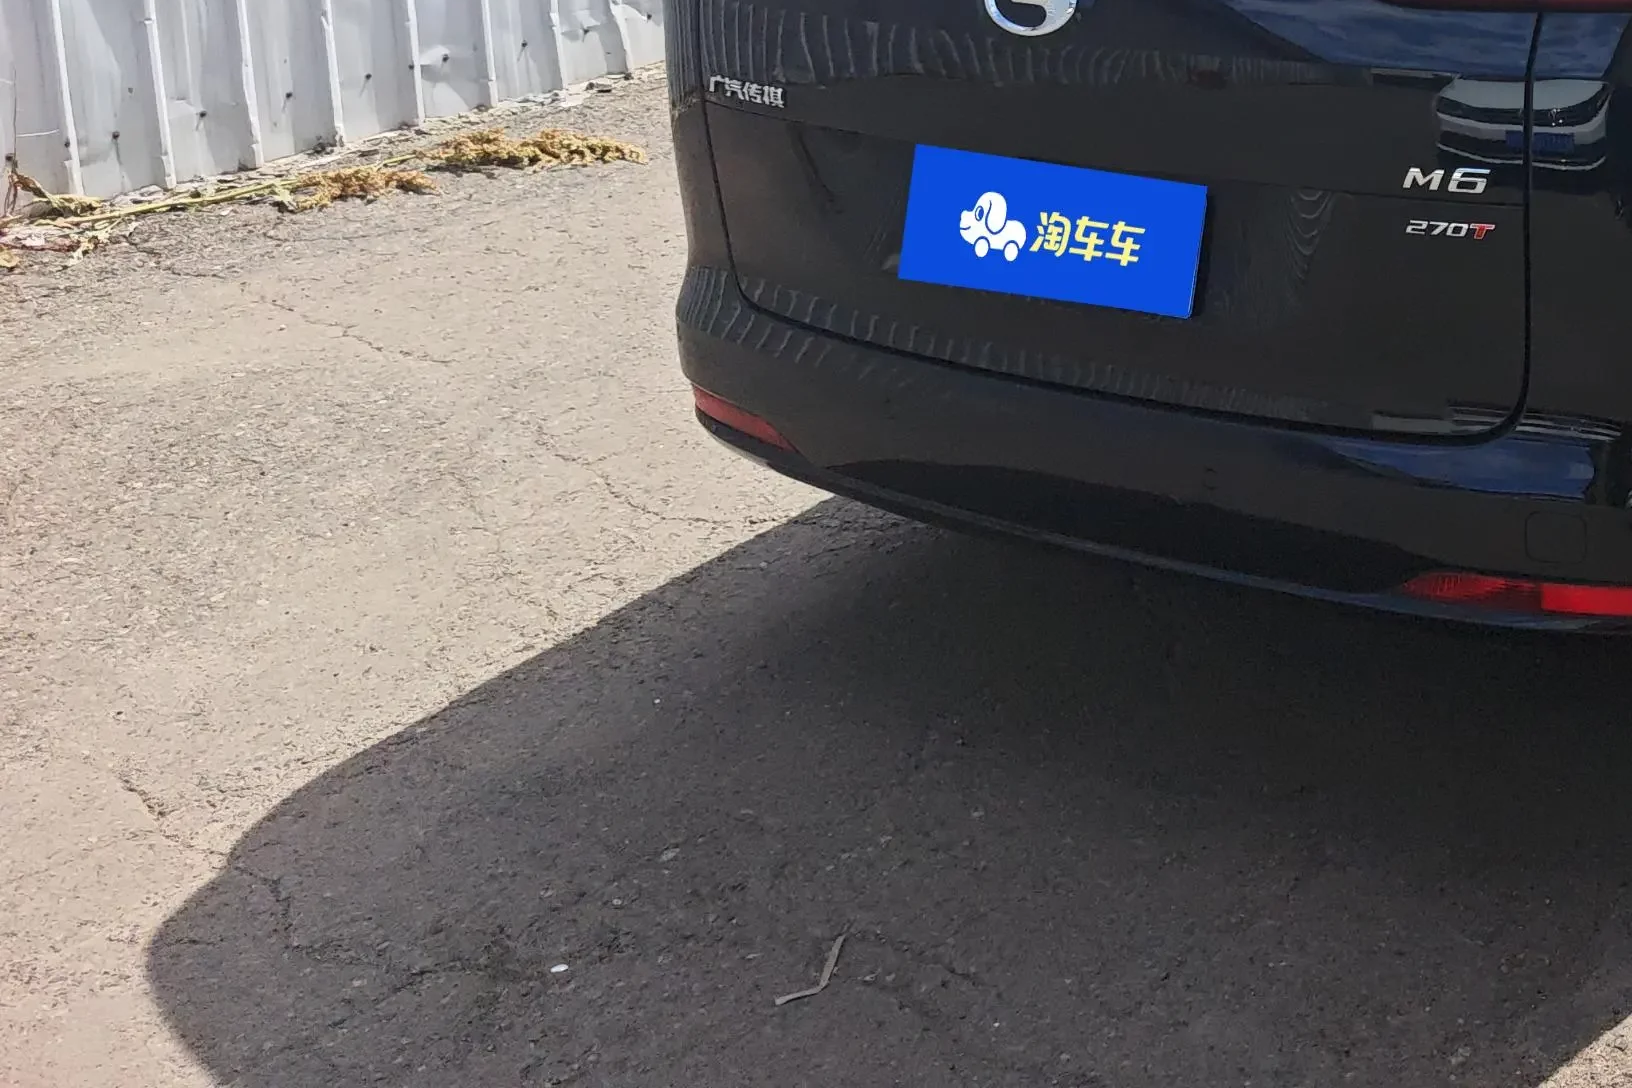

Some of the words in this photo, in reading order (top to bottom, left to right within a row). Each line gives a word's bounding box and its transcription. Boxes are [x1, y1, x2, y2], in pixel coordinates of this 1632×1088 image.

[709, 75, 784, 108] 广汽传祺
[1403, 167, 1491, 193] M6
[1405, 220, 1496, 240] 270T
